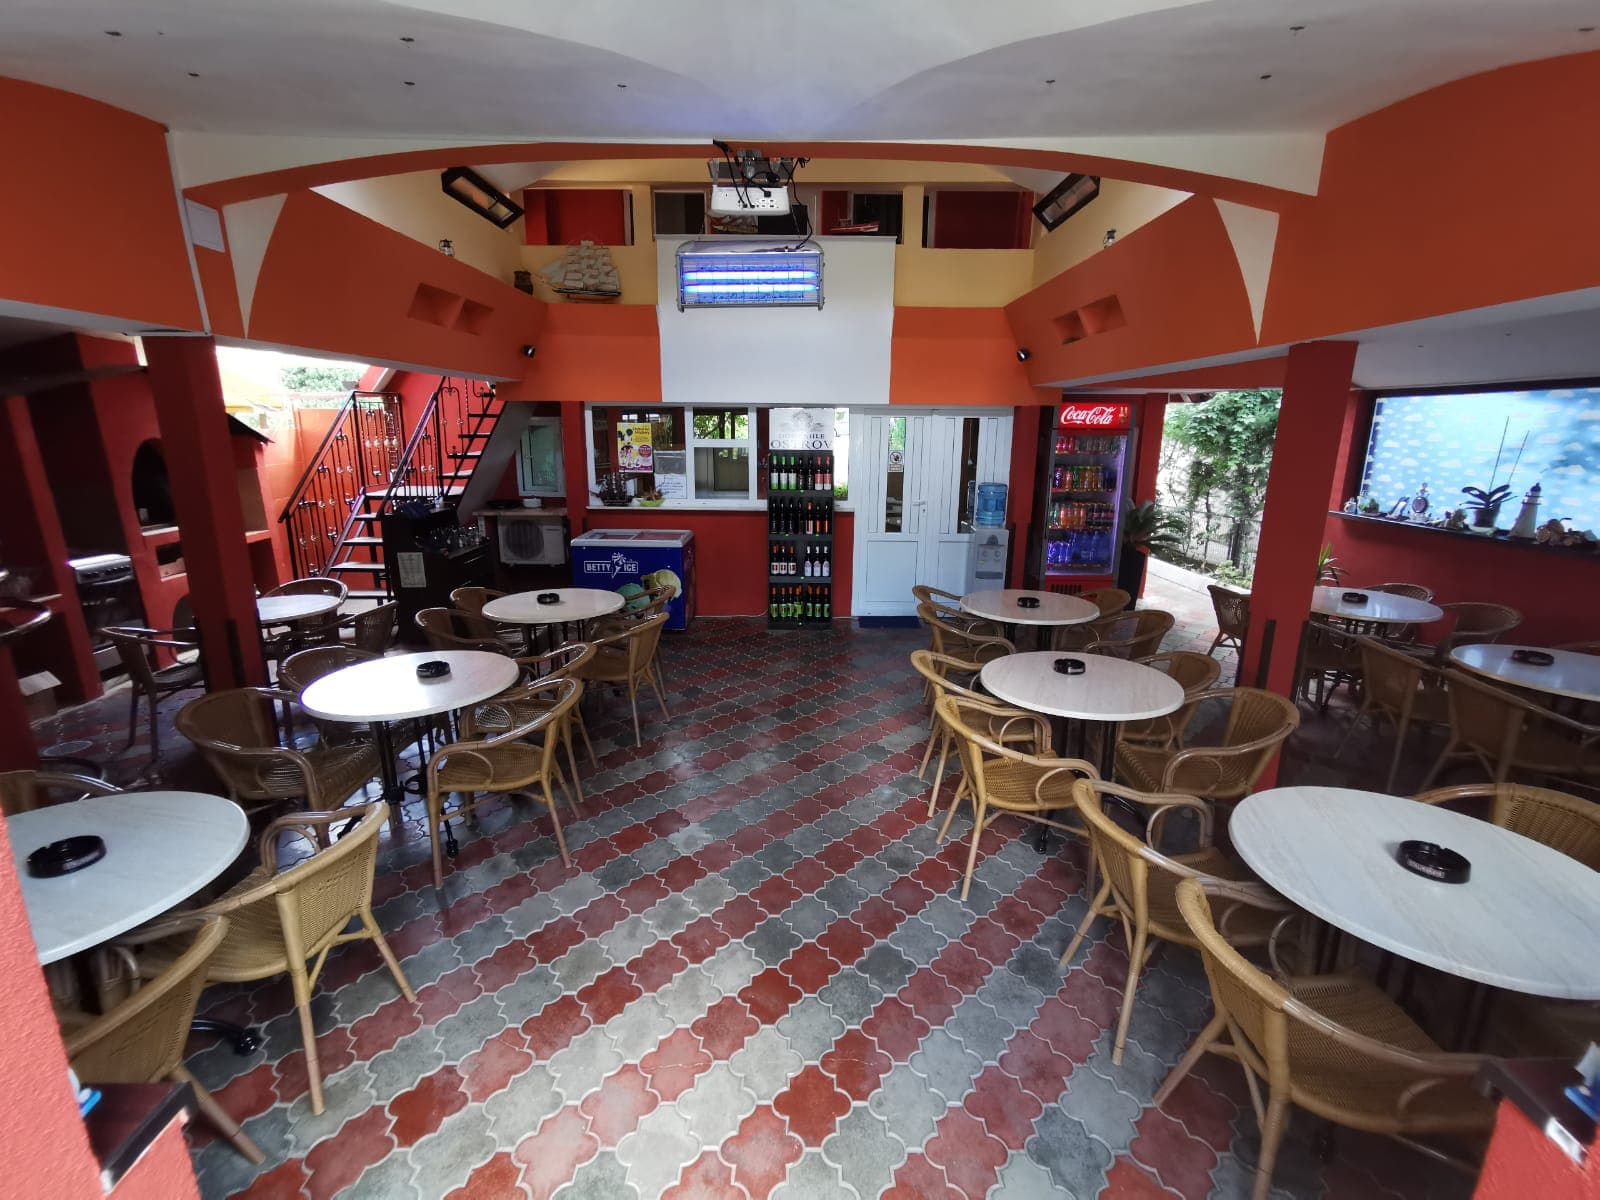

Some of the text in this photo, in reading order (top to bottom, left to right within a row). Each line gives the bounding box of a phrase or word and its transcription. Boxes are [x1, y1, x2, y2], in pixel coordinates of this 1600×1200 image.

[1060, 406, 1116, 424] Coca-Cola
[770, 440, 833, 449] OSTROV
[586, 563, 637, 572] BETTY ICE
